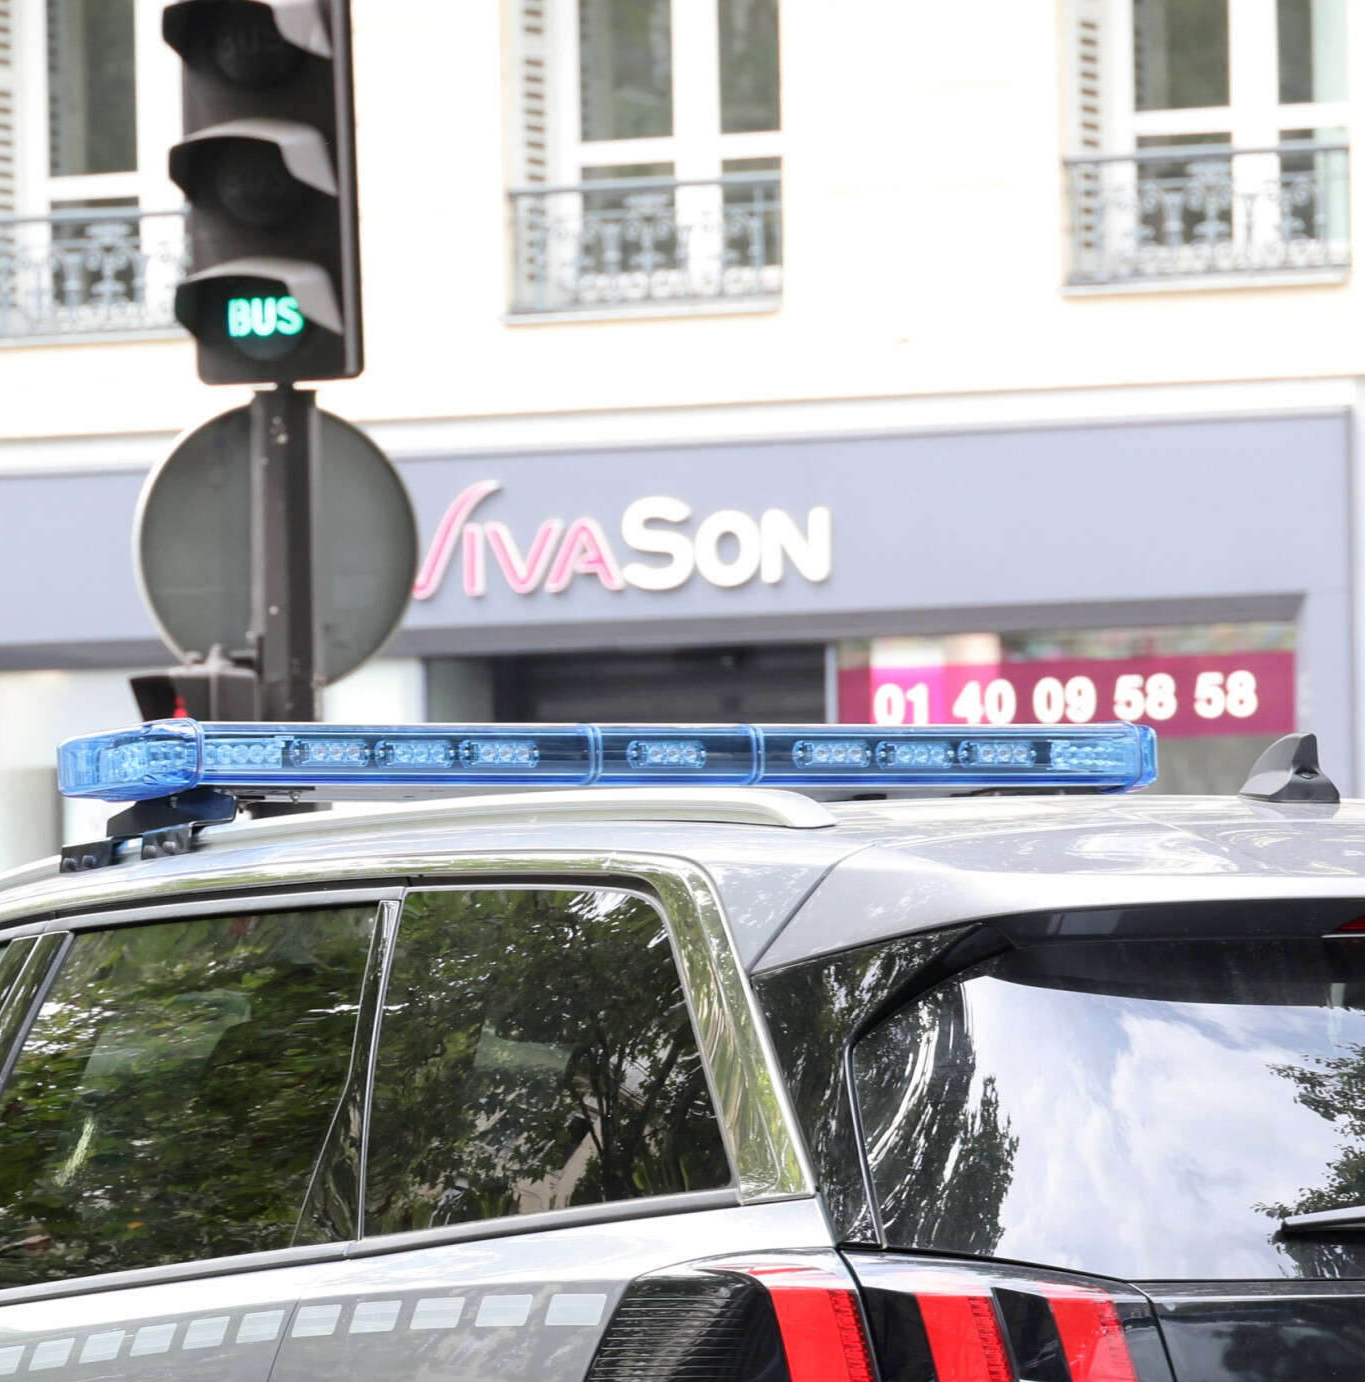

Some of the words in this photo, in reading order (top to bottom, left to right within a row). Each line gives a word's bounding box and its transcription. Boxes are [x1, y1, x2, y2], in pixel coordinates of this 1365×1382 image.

[228, 296, 304, 337] BUS
[873, 682, 930, 725] 01
[953, 678, 1018, 725] 40
[1033, 675, 1098, 723] 09
[1113, 672, 1178, 721] 58
[1194, 670, 1259, 719] 58
